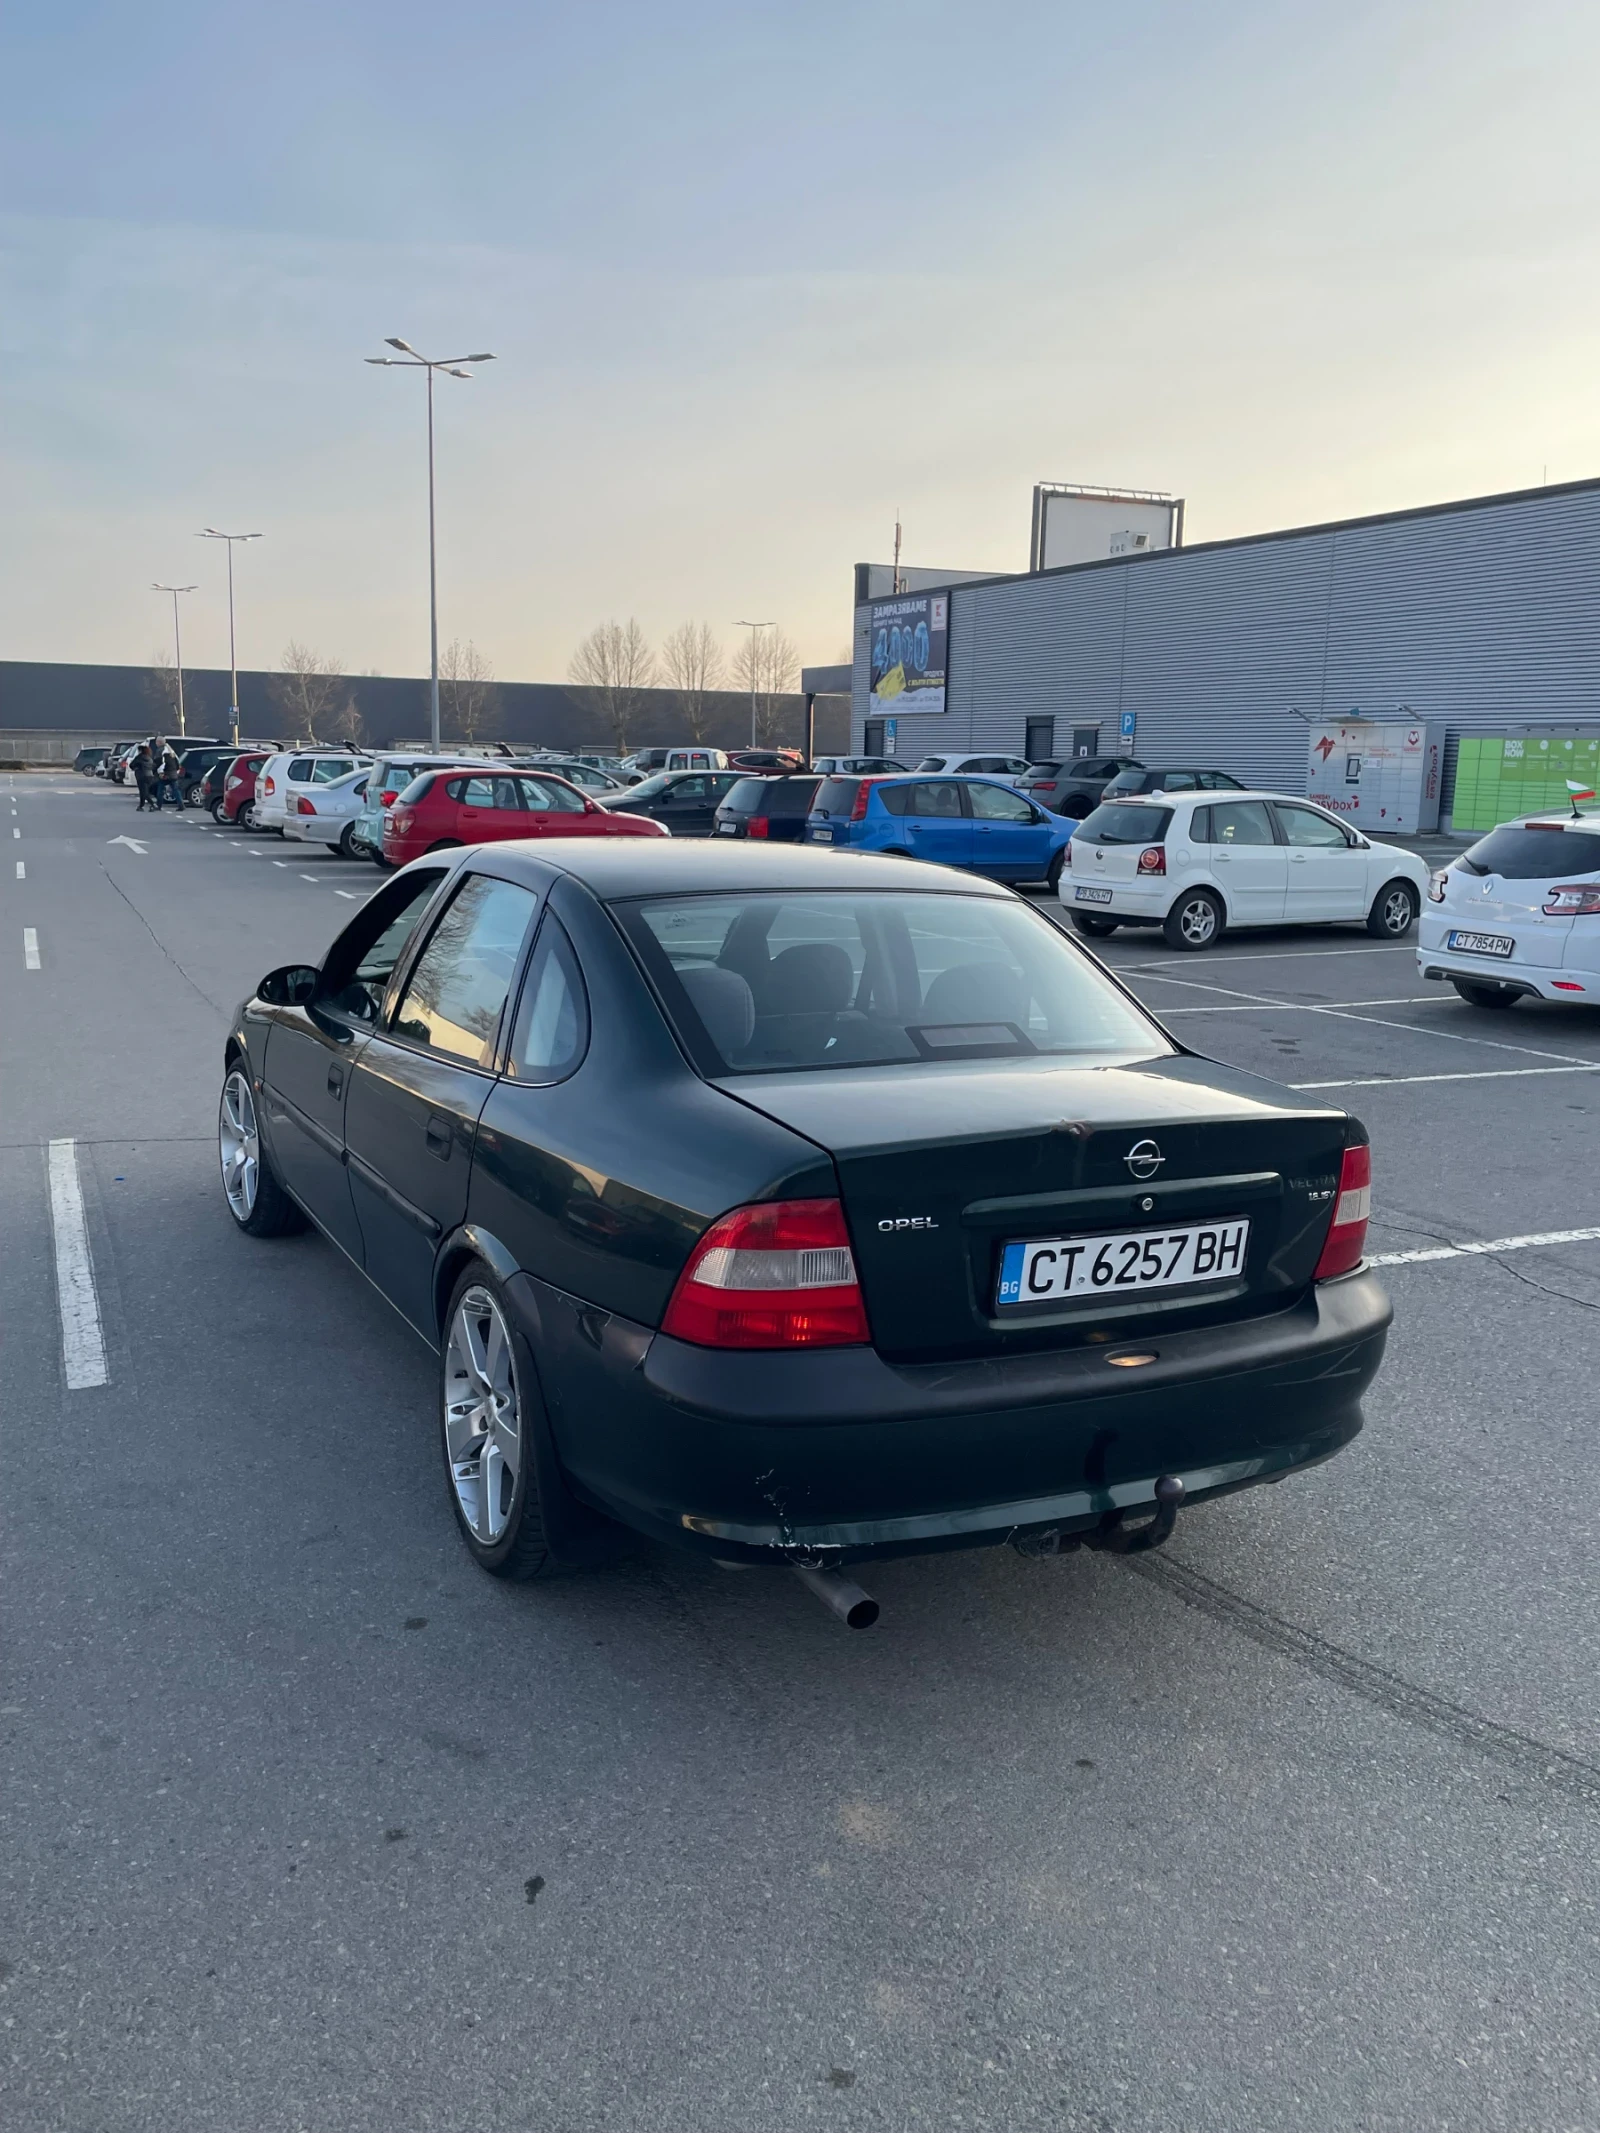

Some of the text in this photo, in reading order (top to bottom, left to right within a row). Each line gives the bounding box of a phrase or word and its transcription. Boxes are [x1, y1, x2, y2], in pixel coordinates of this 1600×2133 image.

[873, 600, 927, 619] ЗАМРАЗЯВАМЕ
[1124, 714, 1132, 731] P
[1505, 740, 1523, 749] BOX
[1504, 749, 1524, 758] NOW
[878, 1216, 939, 1231] OPEL
[1001, 1280, 1018, 1295] BG
